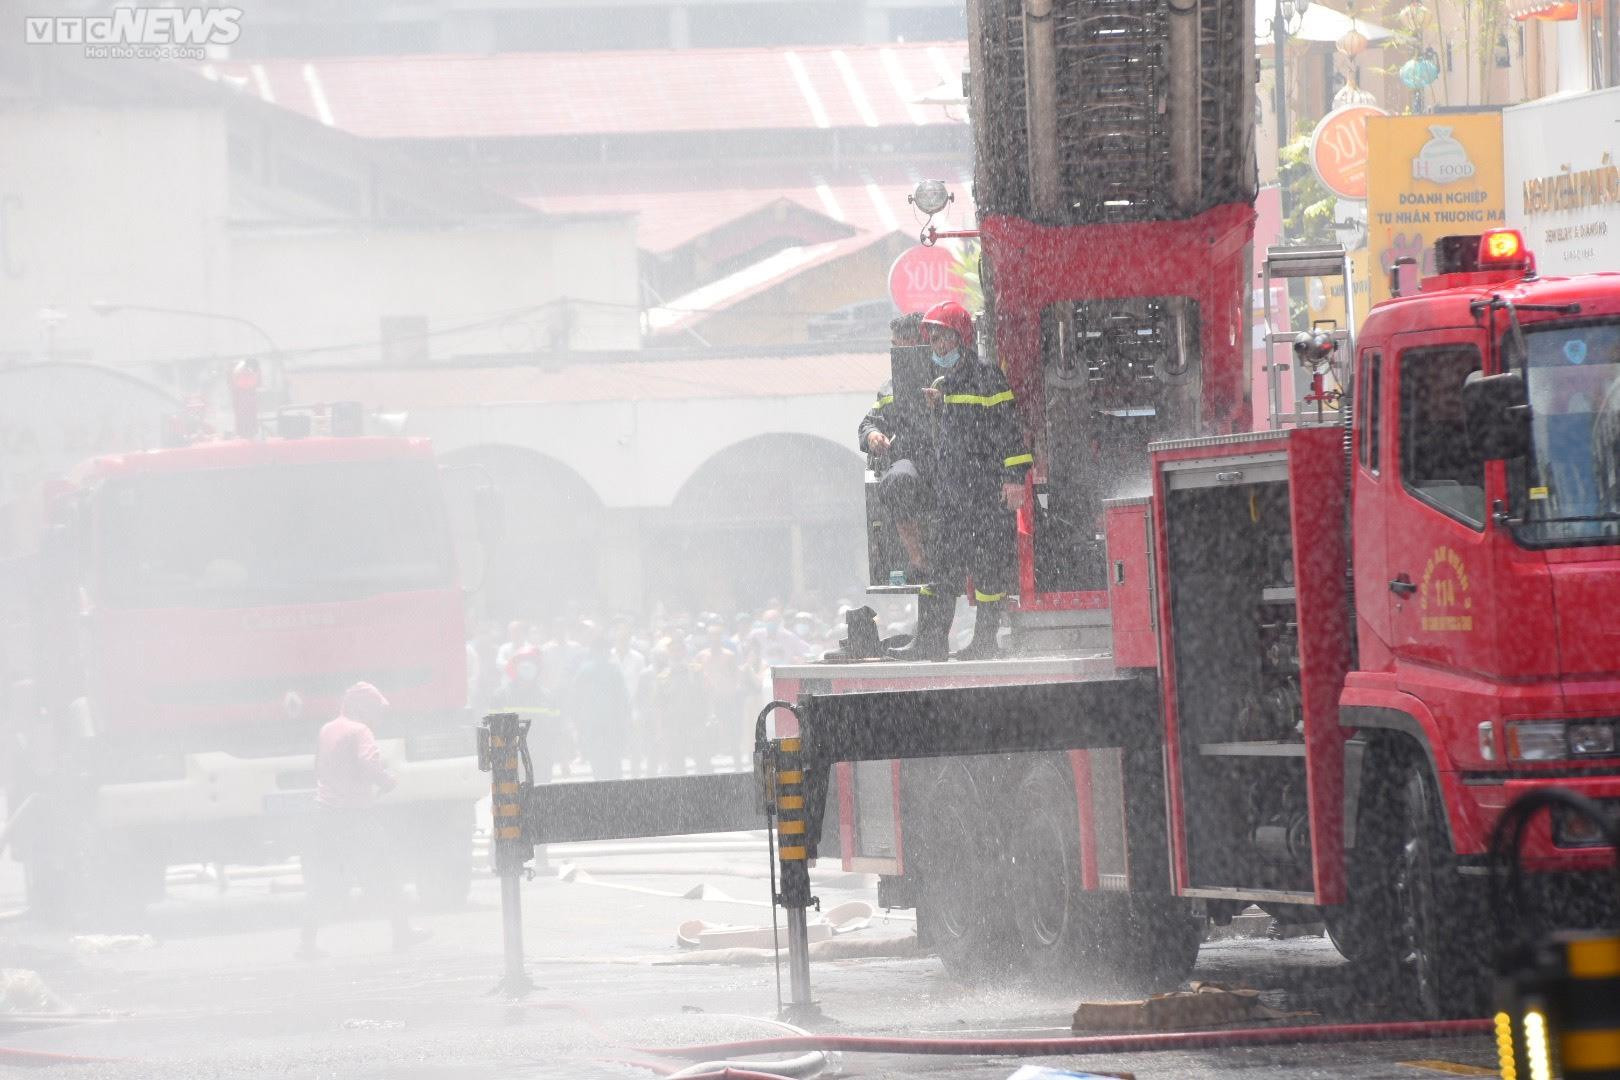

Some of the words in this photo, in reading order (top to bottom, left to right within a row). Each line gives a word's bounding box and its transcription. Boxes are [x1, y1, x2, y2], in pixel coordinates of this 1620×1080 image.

[1322, 115, 1368, 163] SOU
[1439, 164, 1472, 176] FOOD
[1399, 193, 1443, 205] DOANH
[904, 260, 953, 291] SOUL
